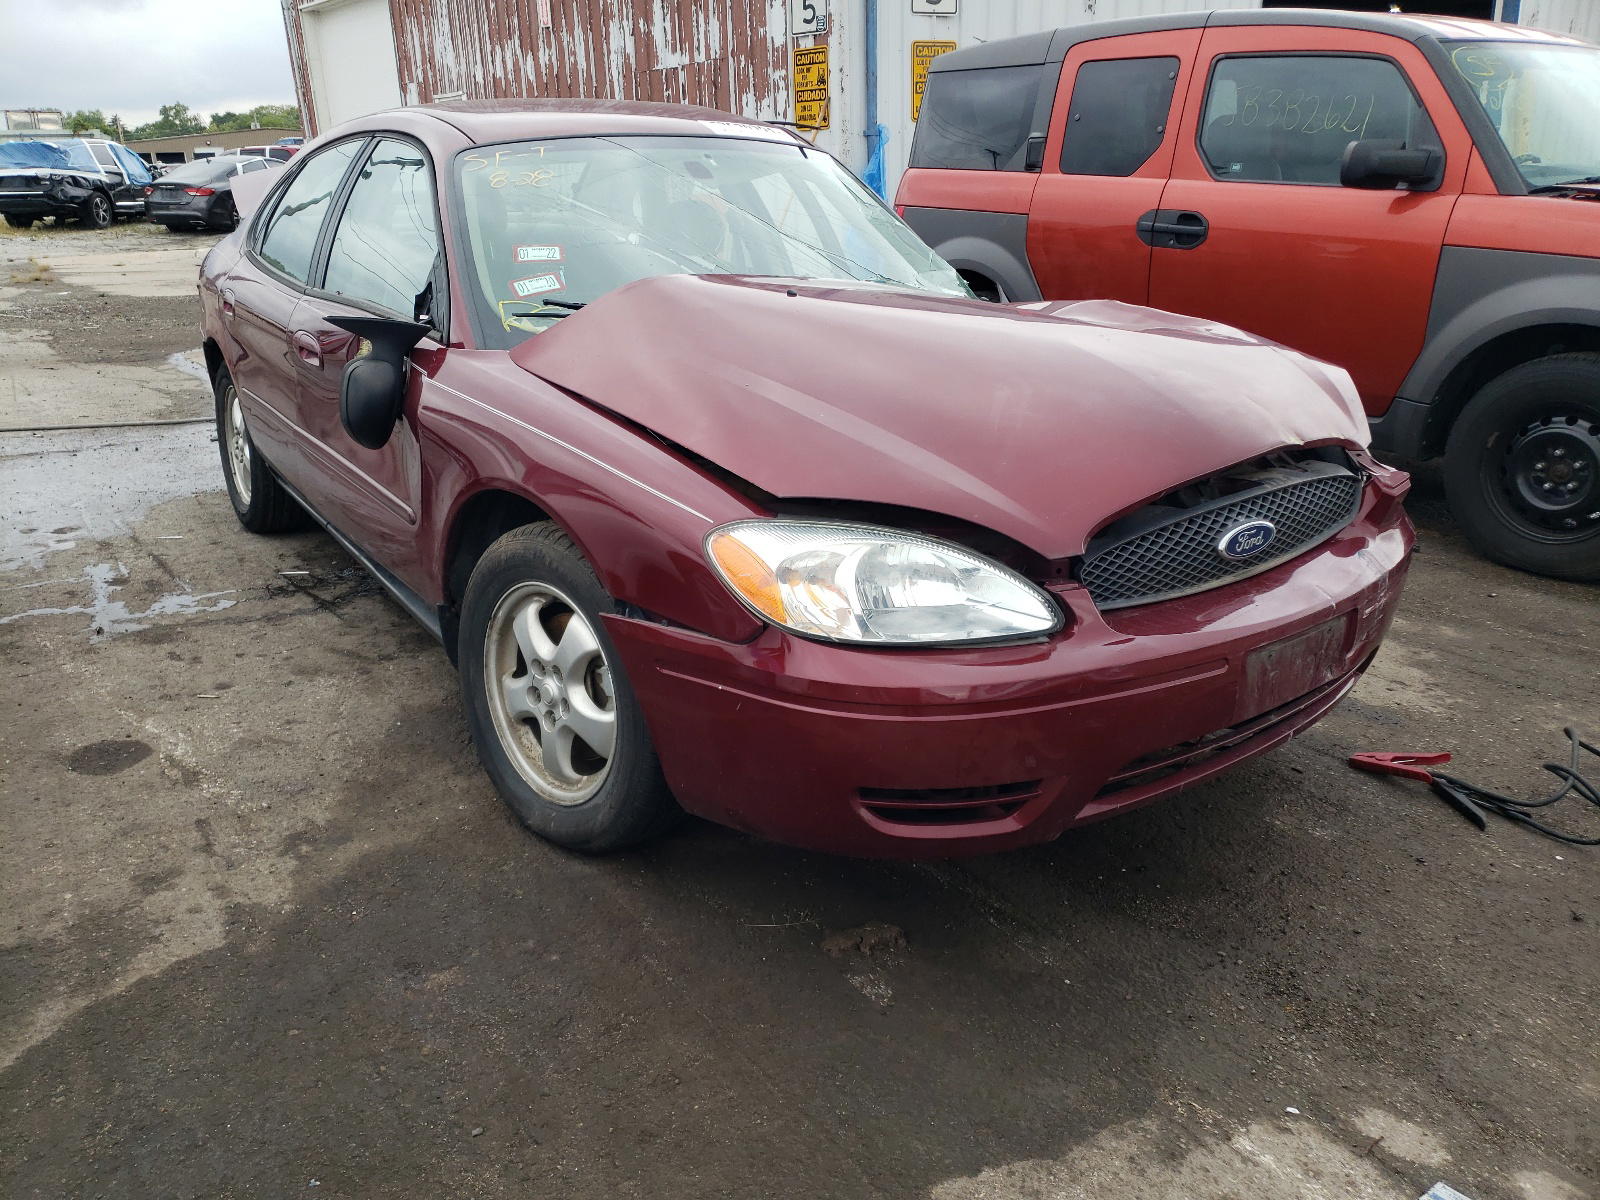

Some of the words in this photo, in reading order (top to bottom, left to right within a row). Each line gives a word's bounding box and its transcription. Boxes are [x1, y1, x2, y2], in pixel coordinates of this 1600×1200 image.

[803, 0, 816, 24] 5
[796, 53, 825, 65] CAUTION
[797, 90, 826, 102] CUIDADO
[518, 248, 529, 260] 01
[546, 247, 558, 260] 22
[1235, 528, 1265, 553] Ford
